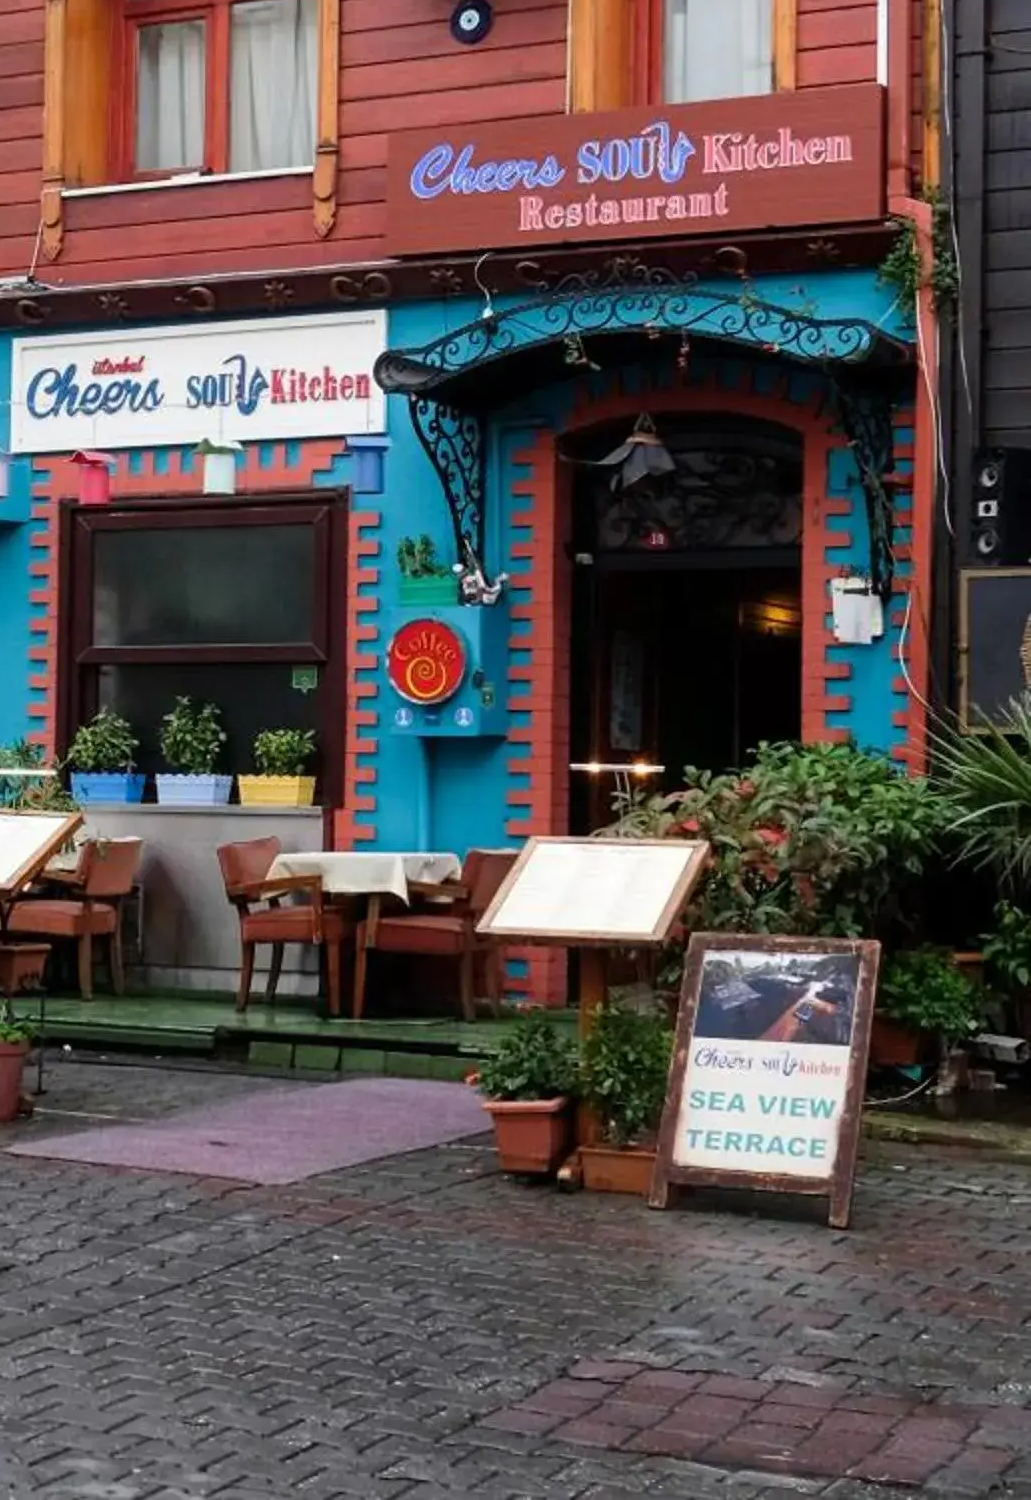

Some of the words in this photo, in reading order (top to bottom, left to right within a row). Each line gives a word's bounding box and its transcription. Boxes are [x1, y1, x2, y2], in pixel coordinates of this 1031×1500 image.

[409, 142, 566, 200] Cheers
[702, 128, 853, 173] Kitchen
[518, 184, 730, 231] Restaurant
[25, 362, 166, 420] Cheers
[270, 366, 373, 405] Kitchen
[394, 631, 457, 662] Coffee
[694, 1047, 753, 1070] Cheers
[688, 1089, 746, 1113] SEA
[758, 1094, 837, 1119] VIEW
[686, 1128, 827, 1159] TERRACE
